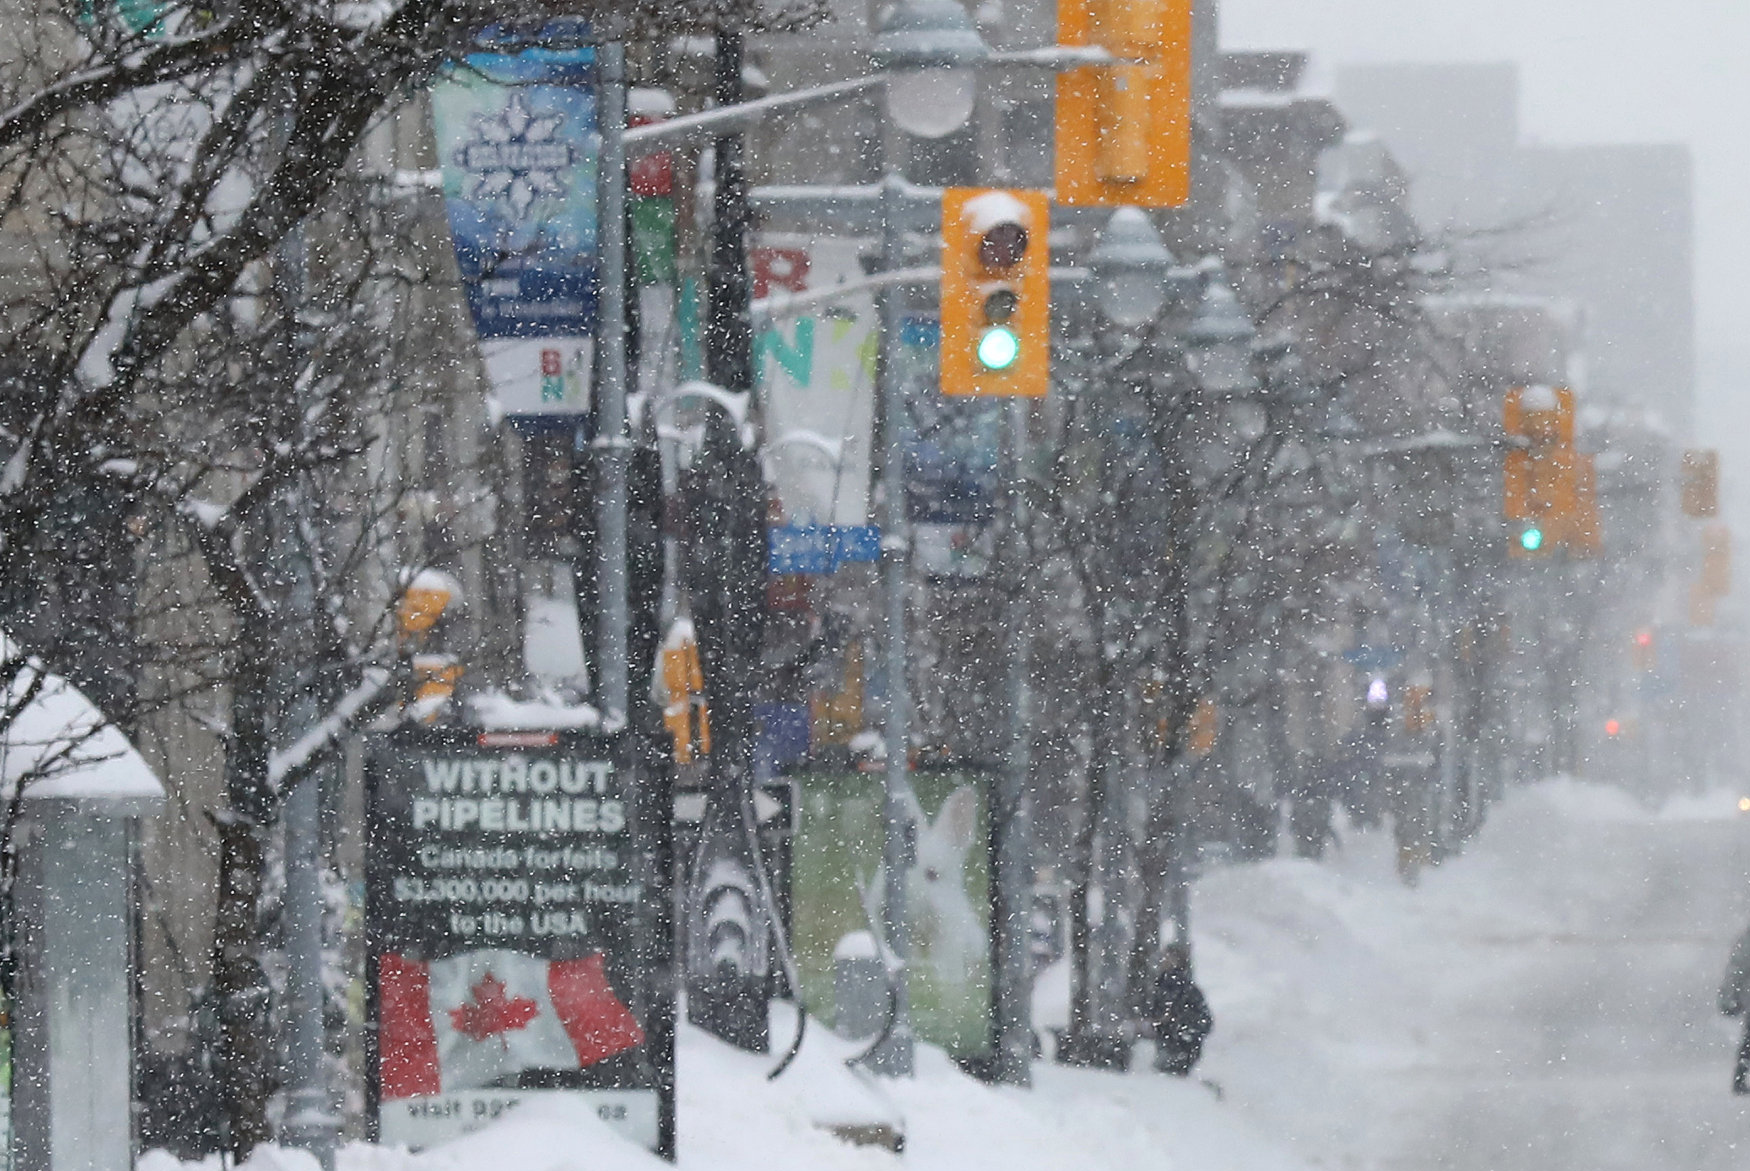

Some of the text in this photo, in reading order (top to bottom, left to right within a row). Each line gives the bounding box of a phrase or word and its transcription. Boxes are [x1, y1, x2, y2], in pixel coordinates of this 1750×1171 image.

[424, 757, 614, 793] WITHOUT
[413, 799, 626, 832] PIPELINES
[420, 848, 618, 869] Canada forfeits
[534, 884, 579, 905] per
[584, 878, 643, 901] hour
[452, 912, 588, 936] to the USA
